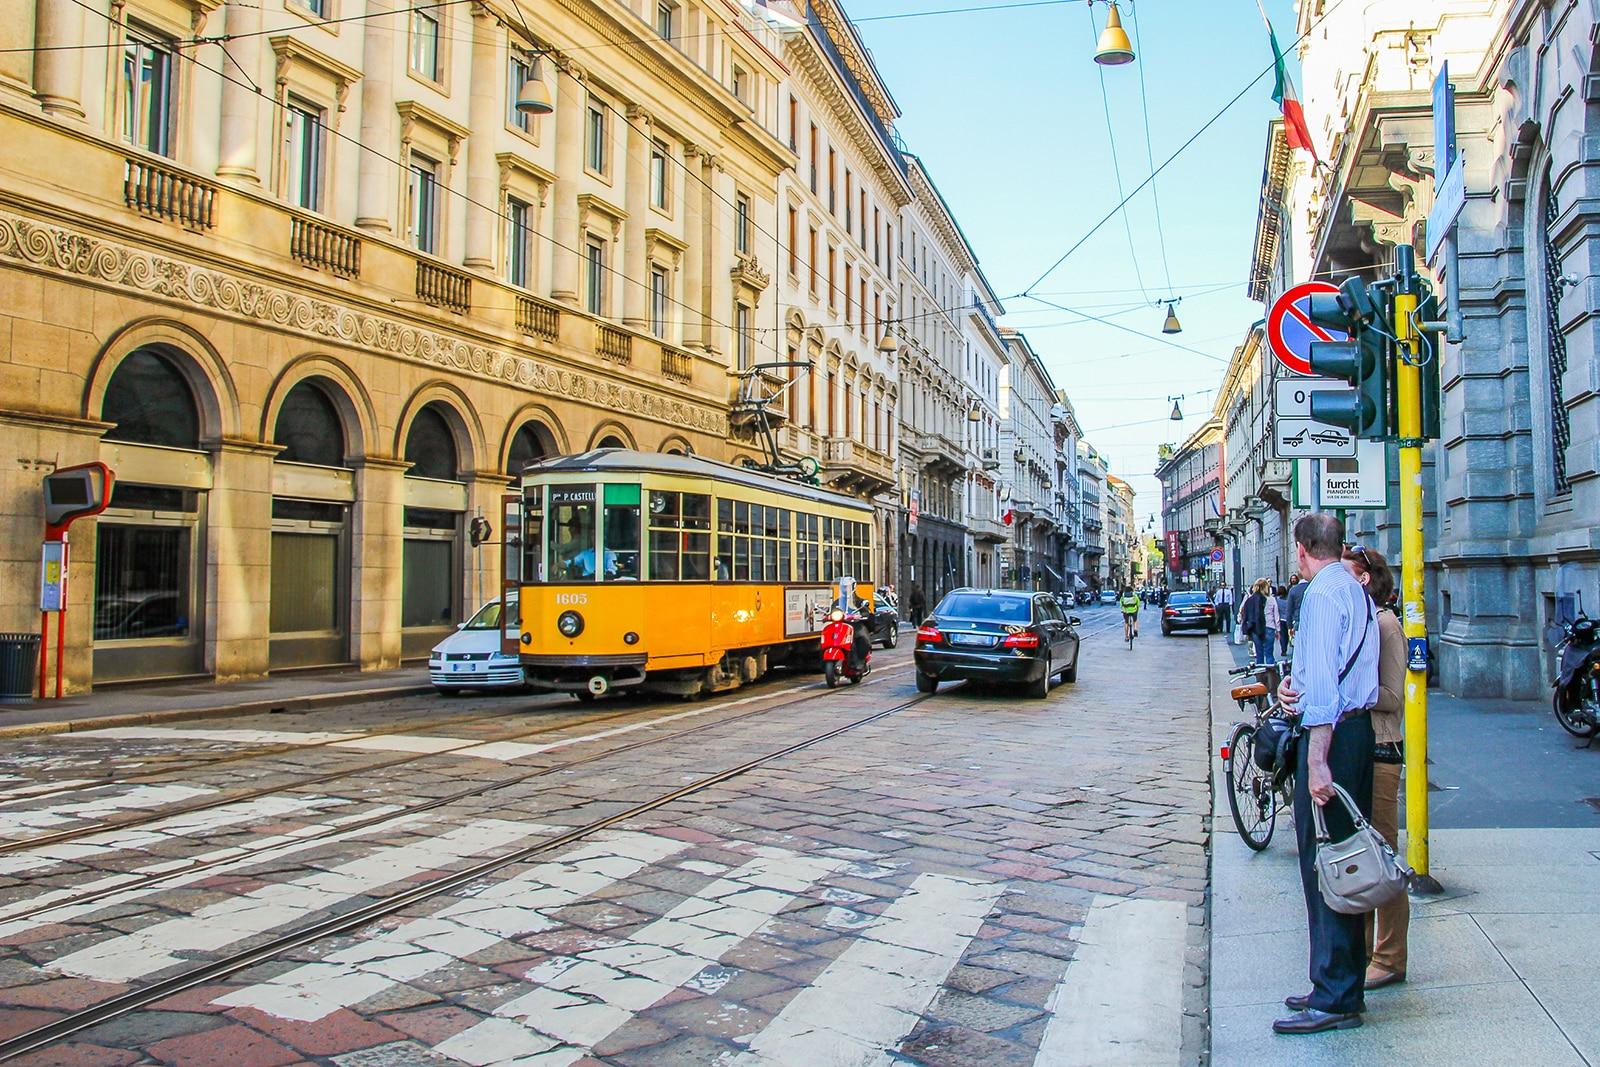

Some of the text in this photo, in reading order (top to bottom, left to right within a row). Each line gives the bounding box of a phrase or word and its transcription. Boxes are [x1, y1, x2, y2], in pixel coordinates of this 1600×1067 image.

[1326, 478, 1360, 489] furcht
[570, 492, 596, 501] CASTELL
[556, 593, 588, 605] 1605
